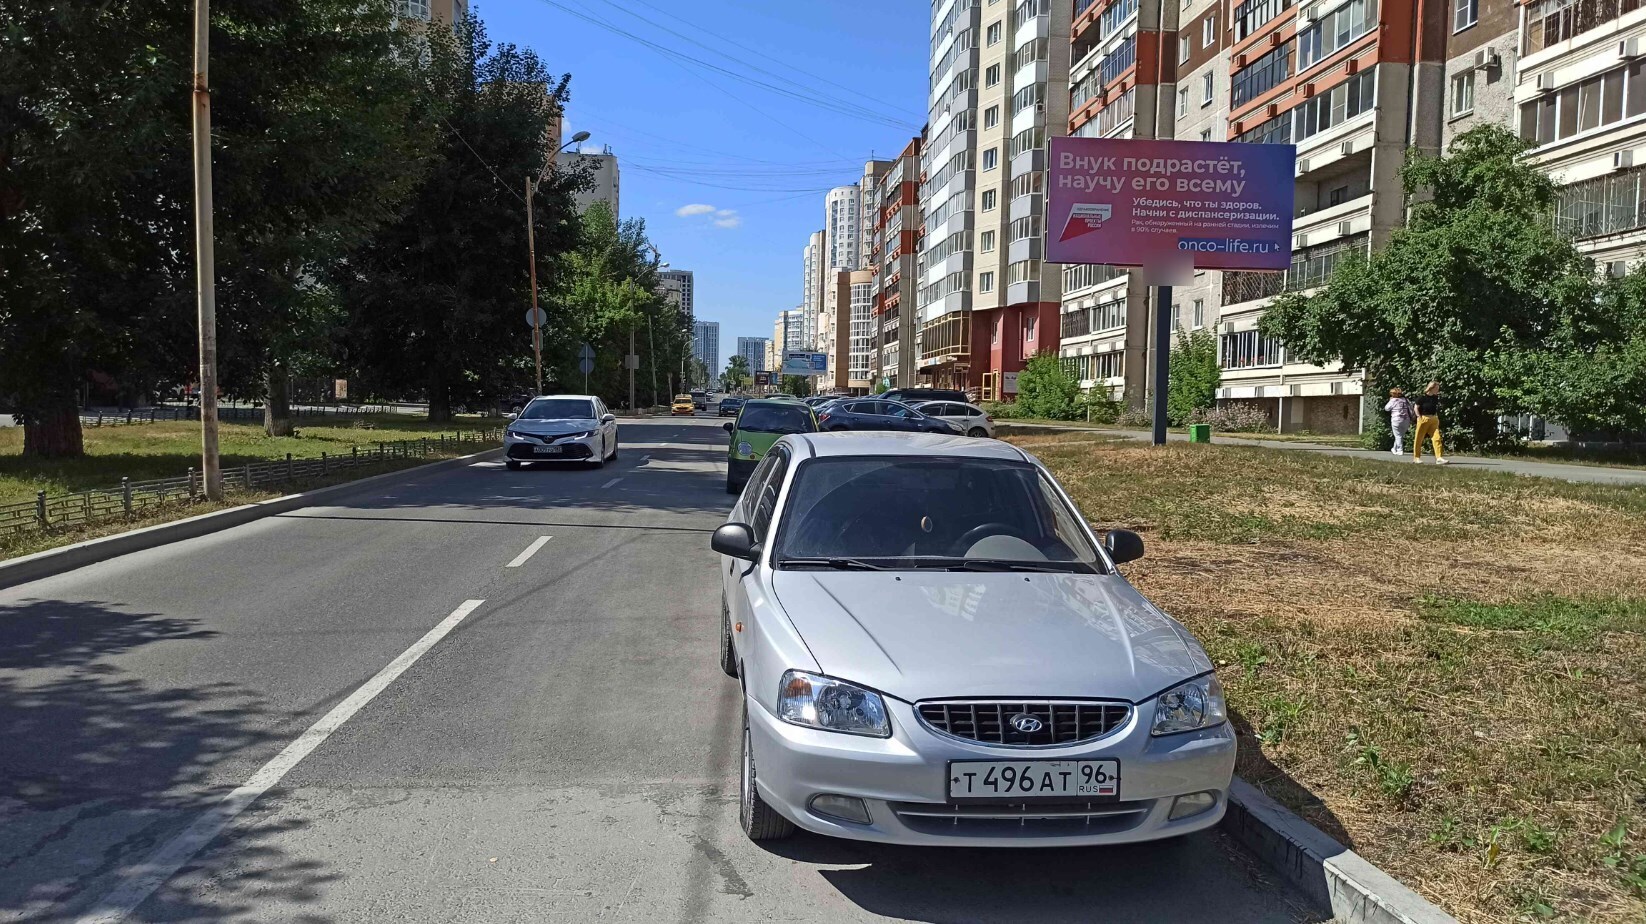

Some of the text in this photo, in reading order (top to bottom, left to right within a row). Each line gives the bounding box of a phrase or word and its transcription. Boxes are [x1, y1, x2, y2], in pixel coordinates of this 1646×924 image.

[1060, 152, 1246, 178] Внук подрастёт,
[1058, 175, 1246, 197] научу его всему
[1132, 197, 1181, 208] Убедись,
[1184, 200, 1202, 208] что
[1220, 201, 1262, 210] здоров.
[1132, 208, 1167, 217] Начни
[1177, 211, 1280, 221] диспансеризации.
[1177, 237, 1269, 253] onco-life.ru
[1080, 764, 1108, 785] 96
[1078, 785, 1099, 793] RUS
